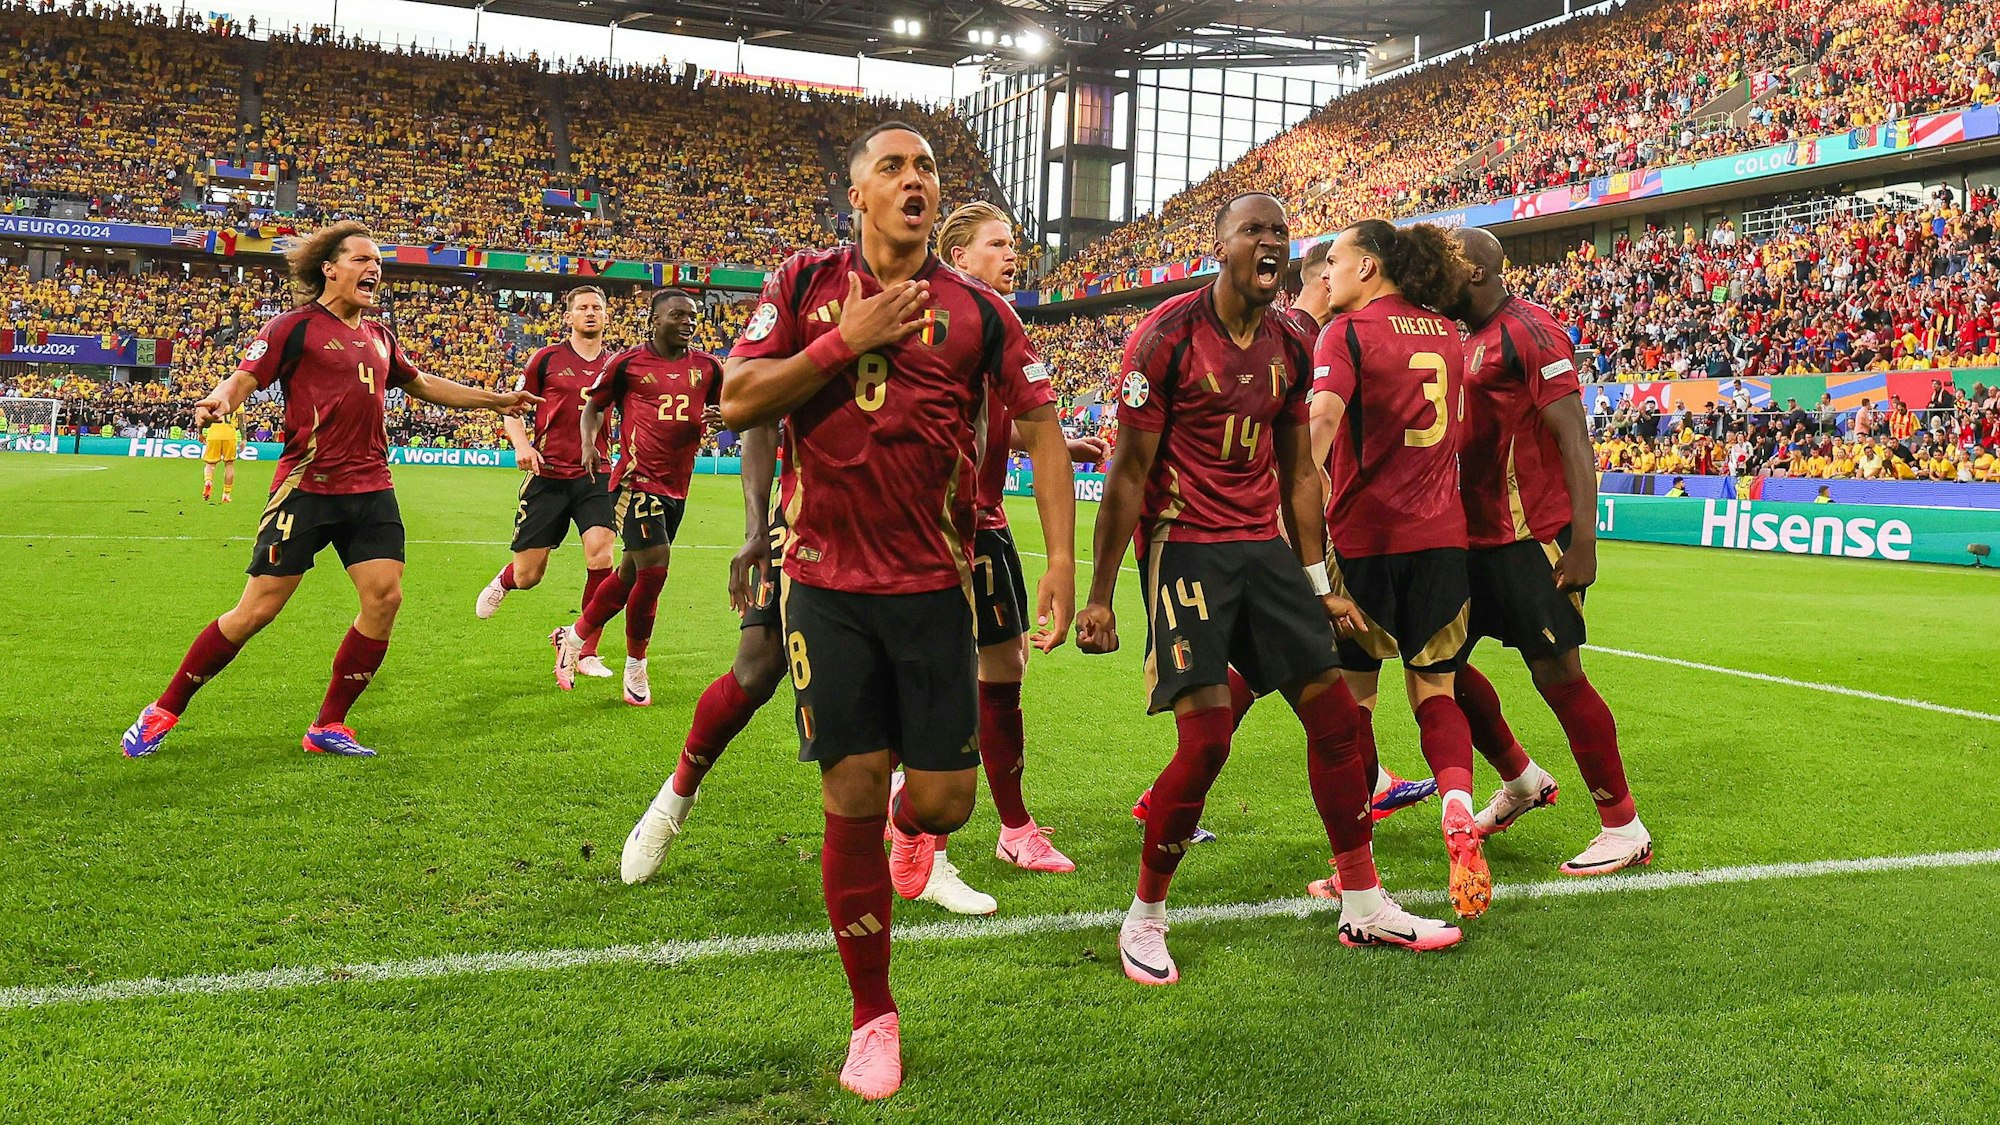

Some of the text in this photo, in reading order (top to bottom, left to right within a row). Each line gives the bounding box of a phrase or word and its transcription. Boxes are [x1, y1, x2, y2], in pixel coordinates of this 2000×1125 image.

[1387, 315, 1448, 336] THEATE
[358, 361, 375, 395] 4
[855, 353, 887, 412] 8
[658, 393, 689, 421] 22
[1404, 351, 1448, 447] 3
[128, 438, 258, 460] Hisee
[1221, 414, 1260, 461] 14
[404, 448, 460, 465] World
[463, 450, 500, 466] No.1
[633, 491, 664, 518] 22
[276, 510, 295, 541] 4
[1701, 499, 1912, 561] Hisense
[974, 554, 994, 596] 7
[1160, 576, 1209, 631] 14
[788, 630, 811, 690] 8
